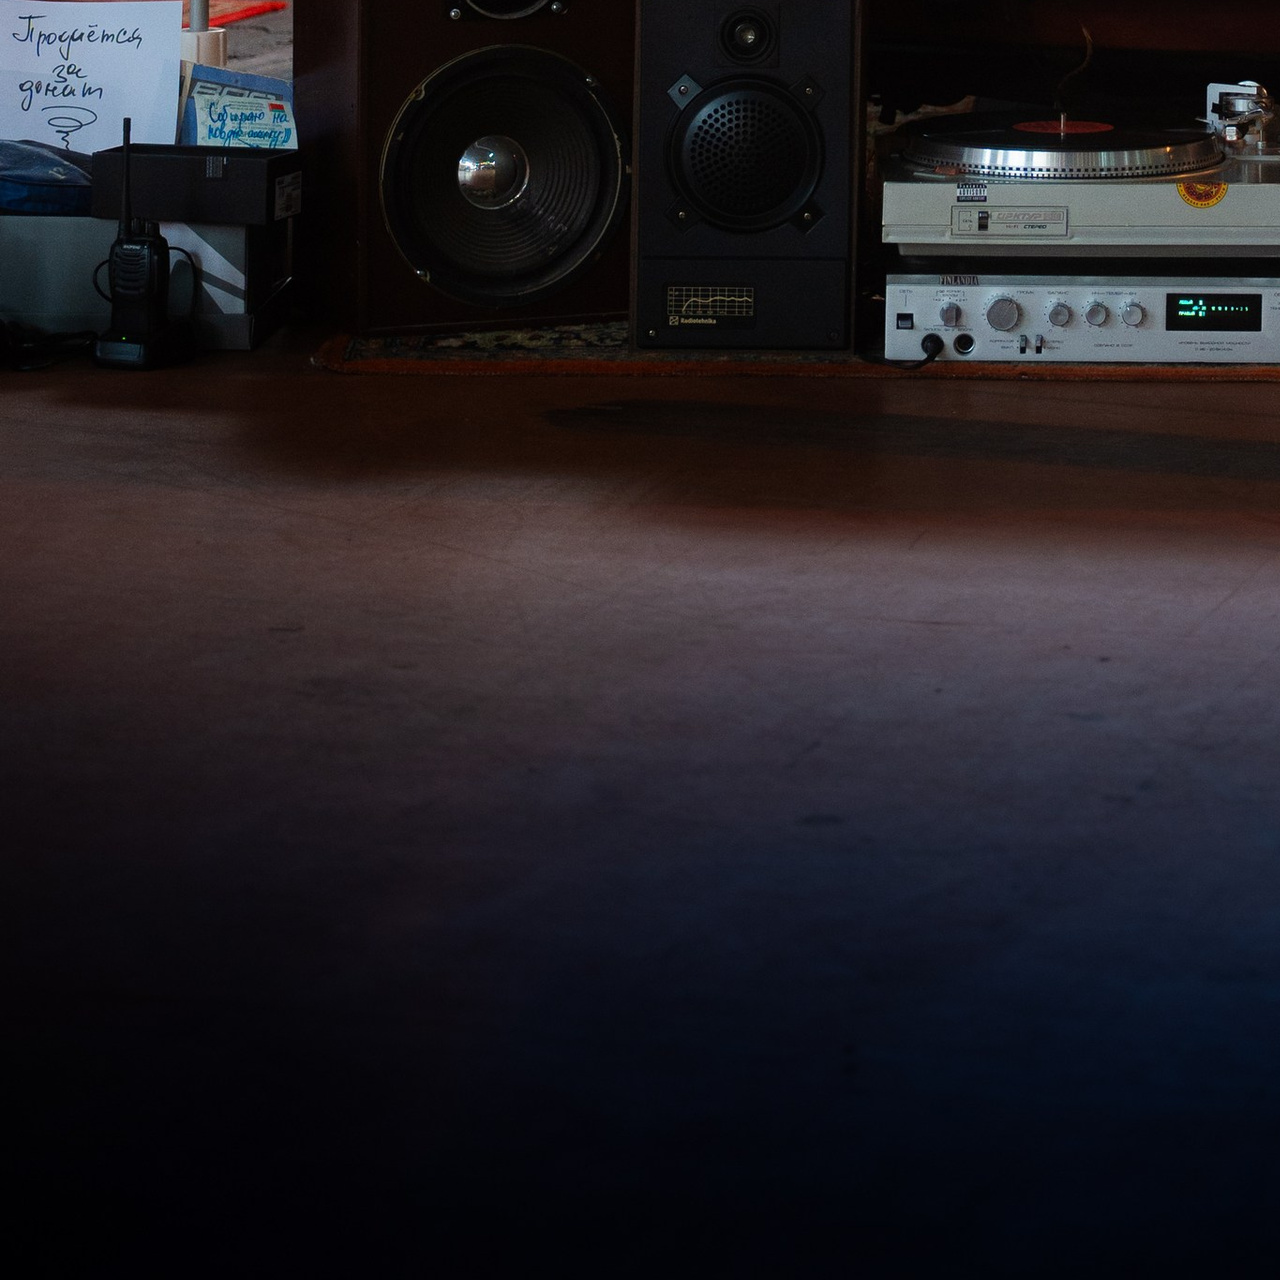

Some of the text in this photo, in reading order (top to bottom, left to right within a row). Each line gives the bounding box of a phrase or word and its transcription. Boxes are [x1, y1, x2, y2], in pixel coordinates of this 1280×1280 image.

[52, 63, 88, 83] за
[18, 80, 104, 112] донат
[272, 112, 289, 124] на
